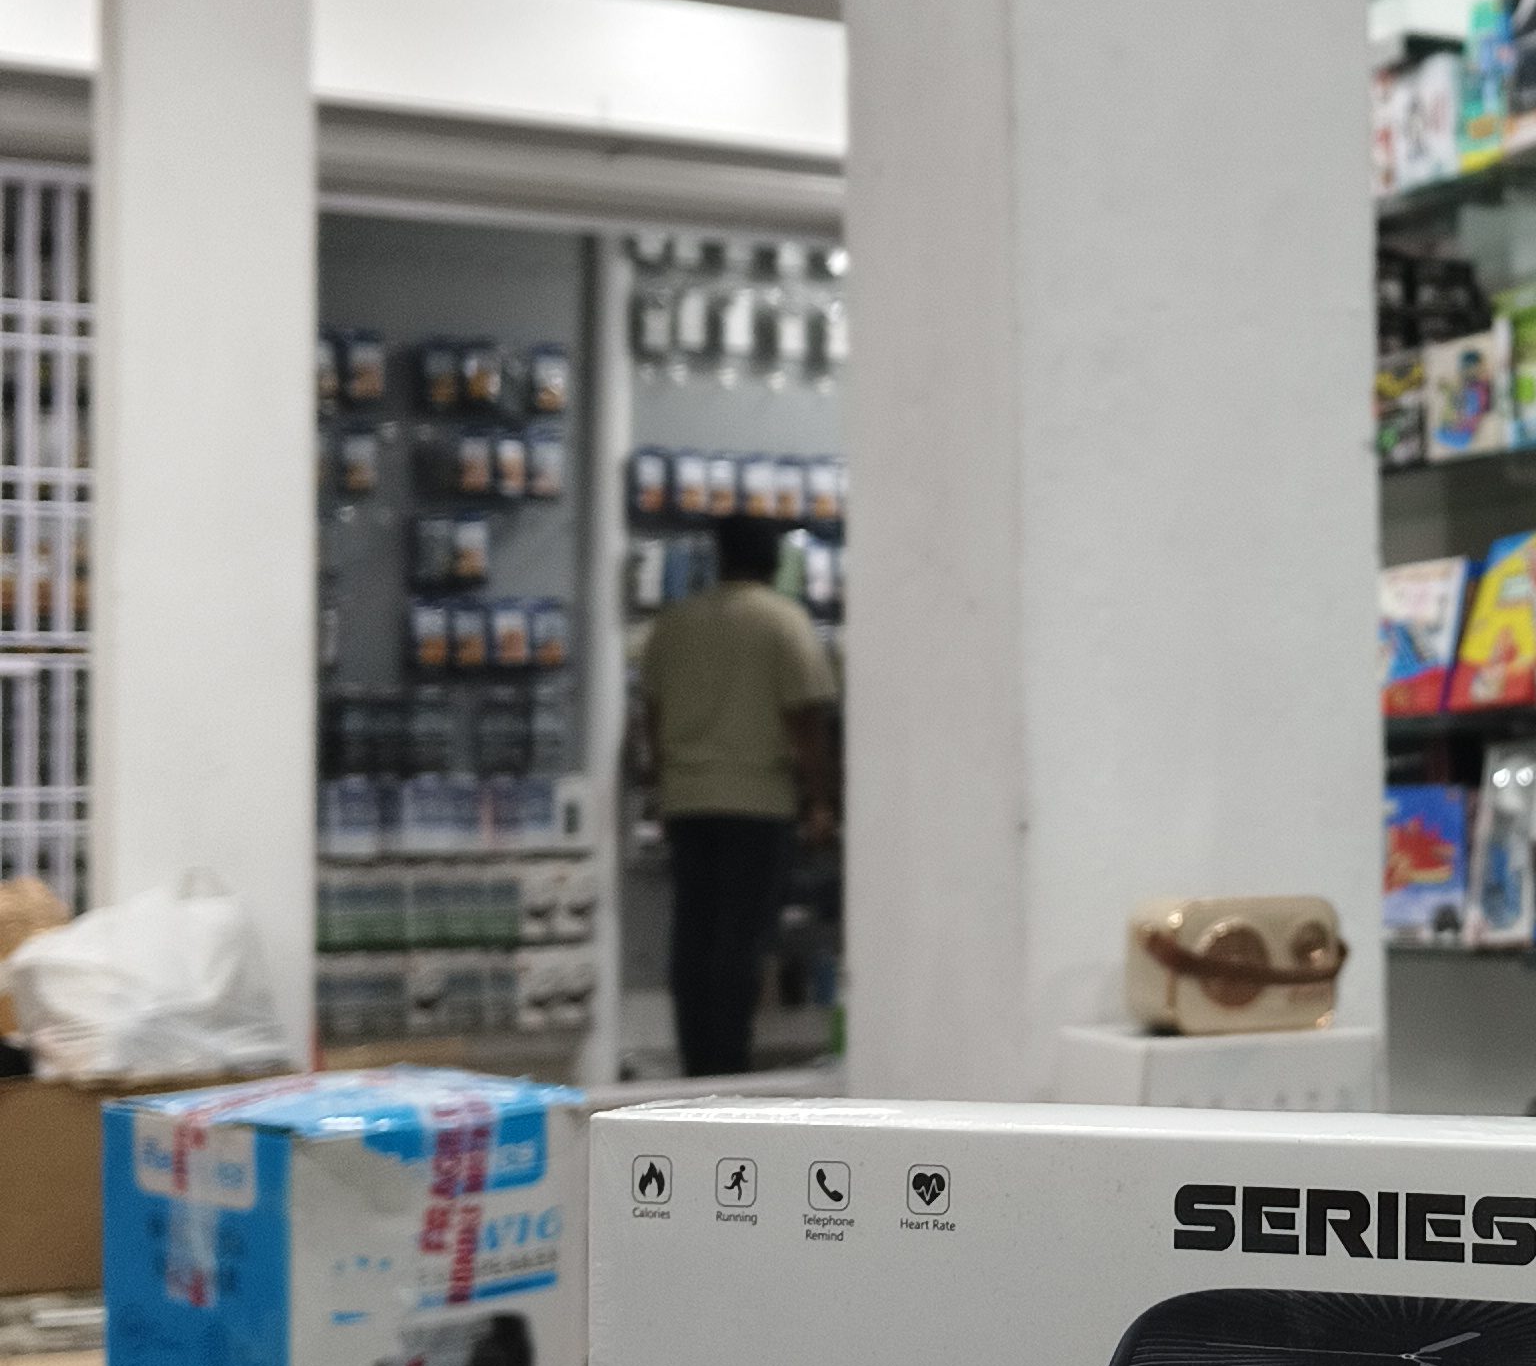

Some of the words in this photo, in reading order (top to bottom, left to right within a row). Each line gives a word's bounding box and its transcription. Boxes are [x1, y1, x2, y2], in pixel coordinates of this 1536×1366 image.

[631, 1206, 671, 1221] Calories
[715, 1211, 758, 1226] Running
[802, 1213, 855, 1229] Telephone
[900, 1218, 930, 1231] Heart
[932, 1220, 956, 1232] Rate
[805, 1228, 845, 1242] Remind
